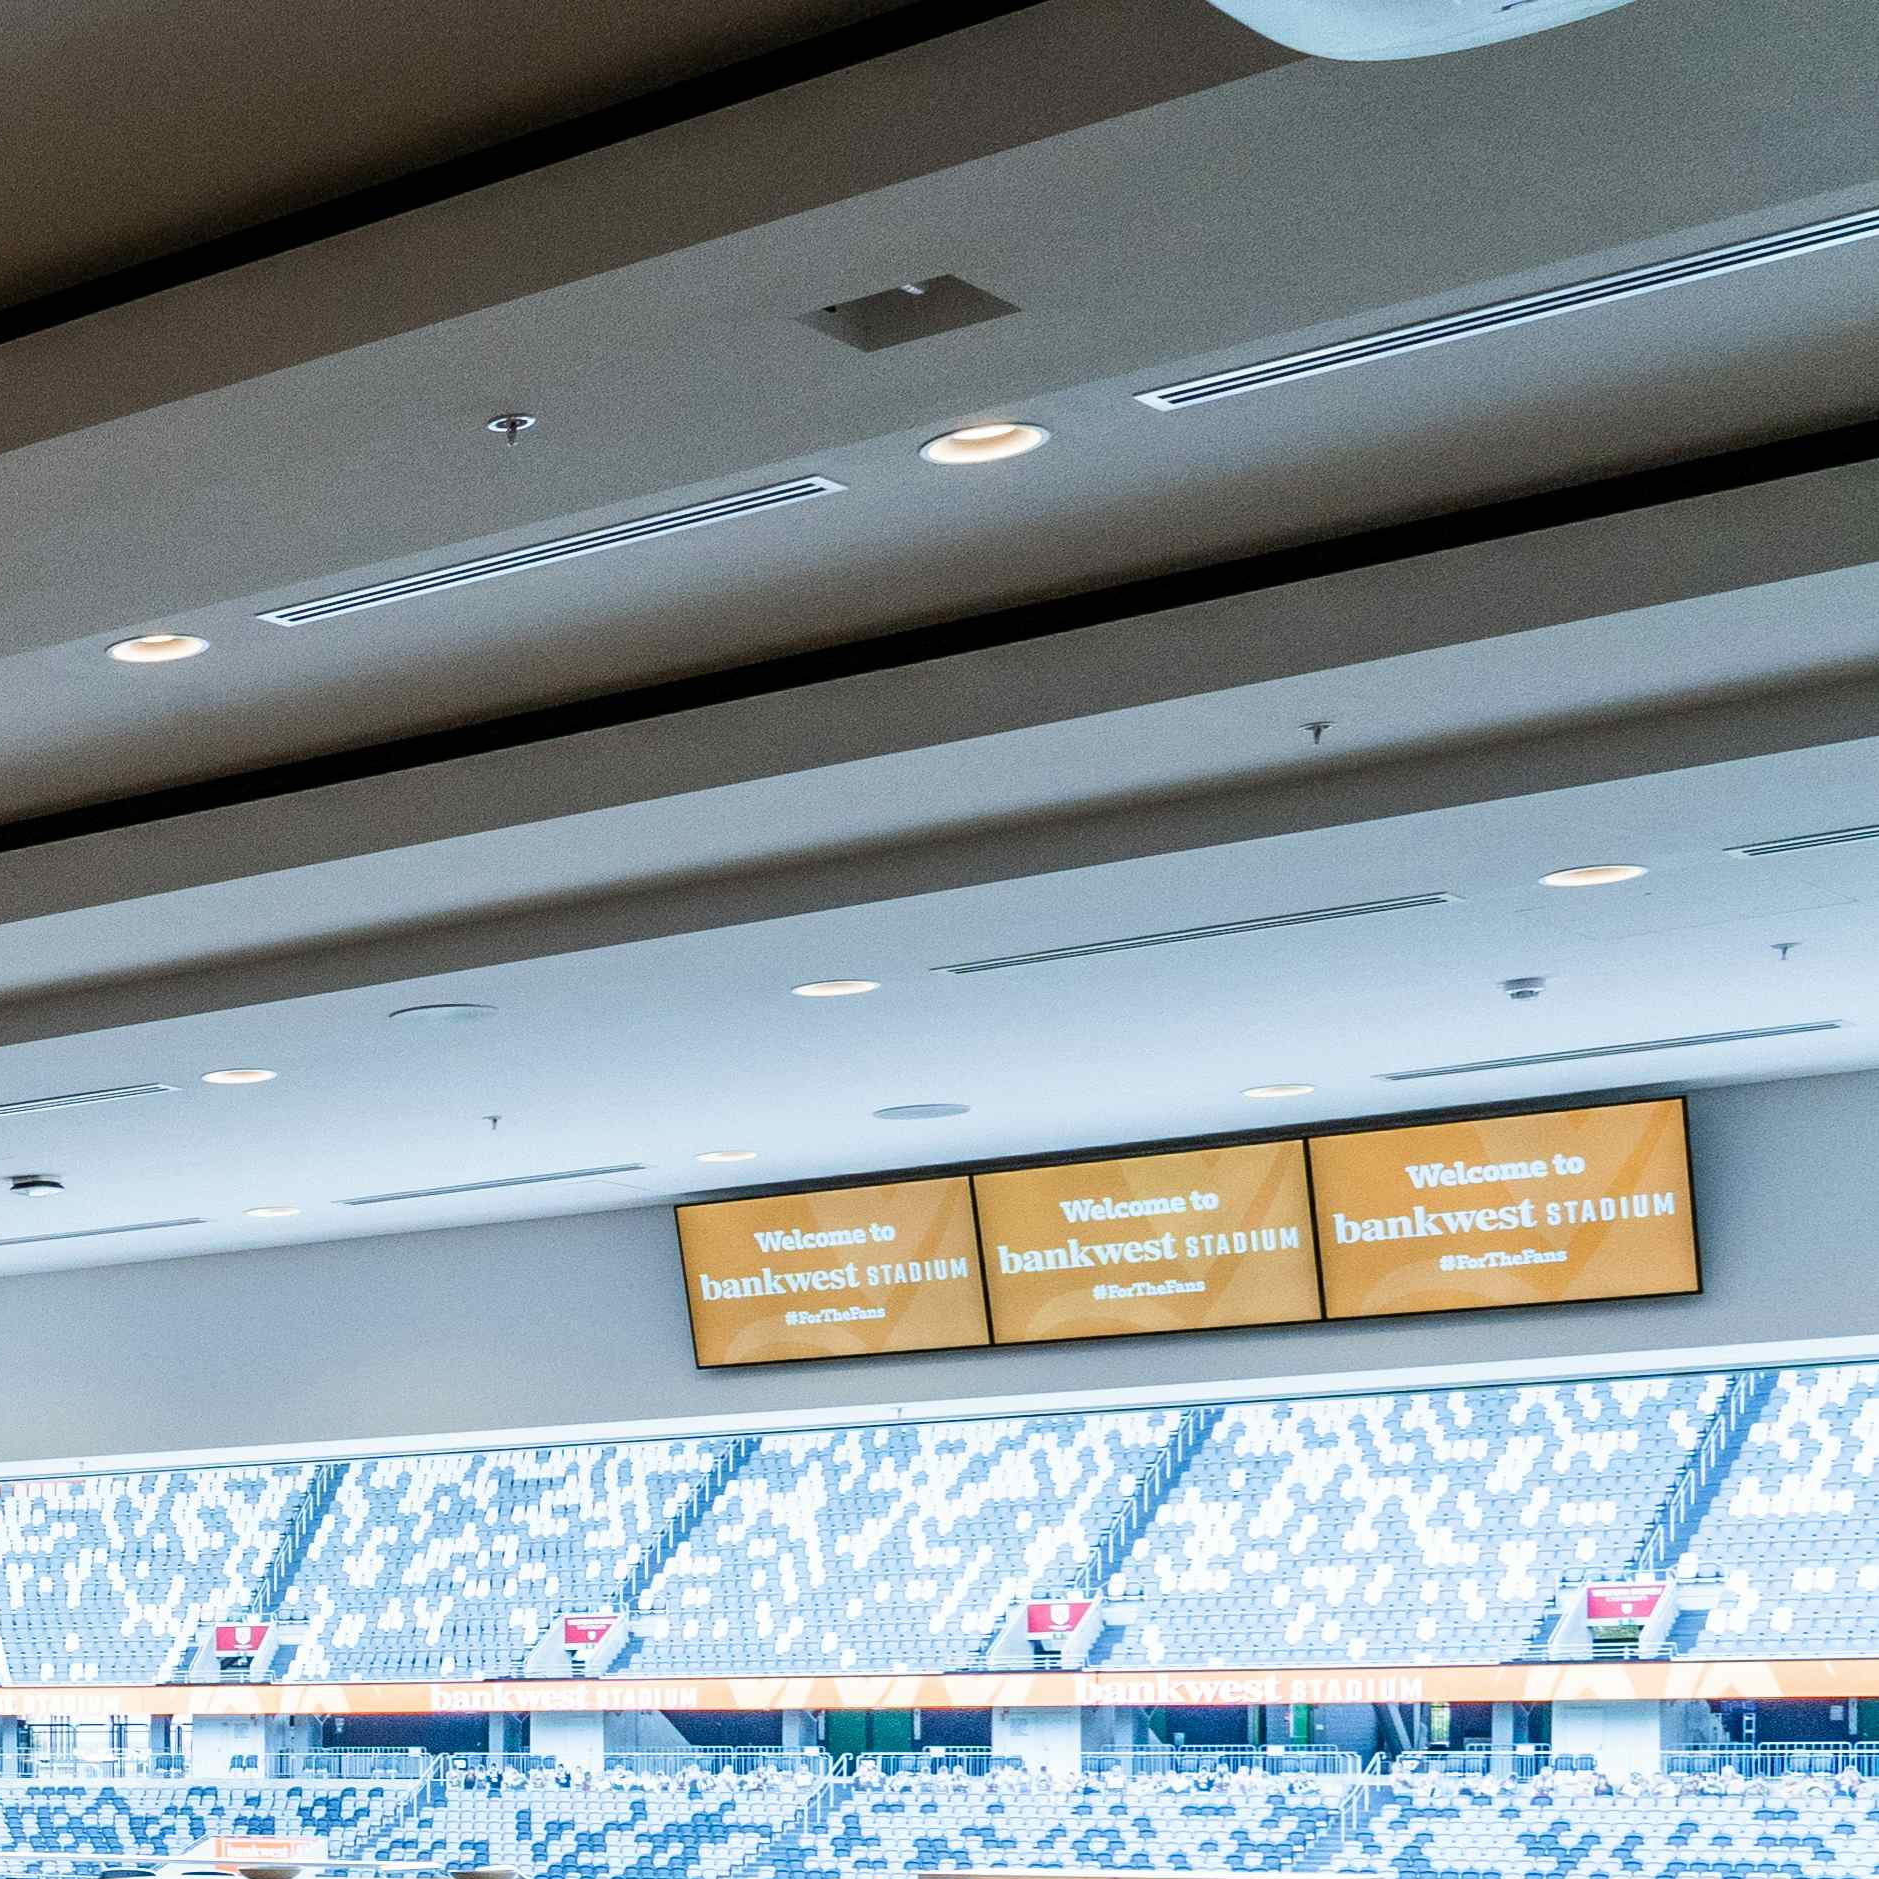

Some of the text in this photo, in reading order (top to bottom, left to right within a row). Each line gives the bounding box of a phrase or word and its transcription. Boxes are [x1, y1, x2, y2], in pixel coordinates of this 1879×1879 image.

[1405, 1152, 1587, 1190] Welcome to
[1059, 1190, 1220, 1223] Welcome to
[1332, 1191, 1676, 1245] bankwest STADIUM
[753, 1222, 896, 1253] Welcome to
[996, 1226, 1300, 1275] bankwest STADIUM
[1439, 1248, 1568, 1272] #ForTheFans
[698, 1257, 970, 1302] bankwest STADIUM
[1092, 1278, 1207, 1301] #ForTheFans
[785, 1305, 887, 1327] #ForTheFans
[430, 1683, 699, 1712] bankwest STADIUM
[1069, 1673, 1424, 1705] bankwest STADIUM
